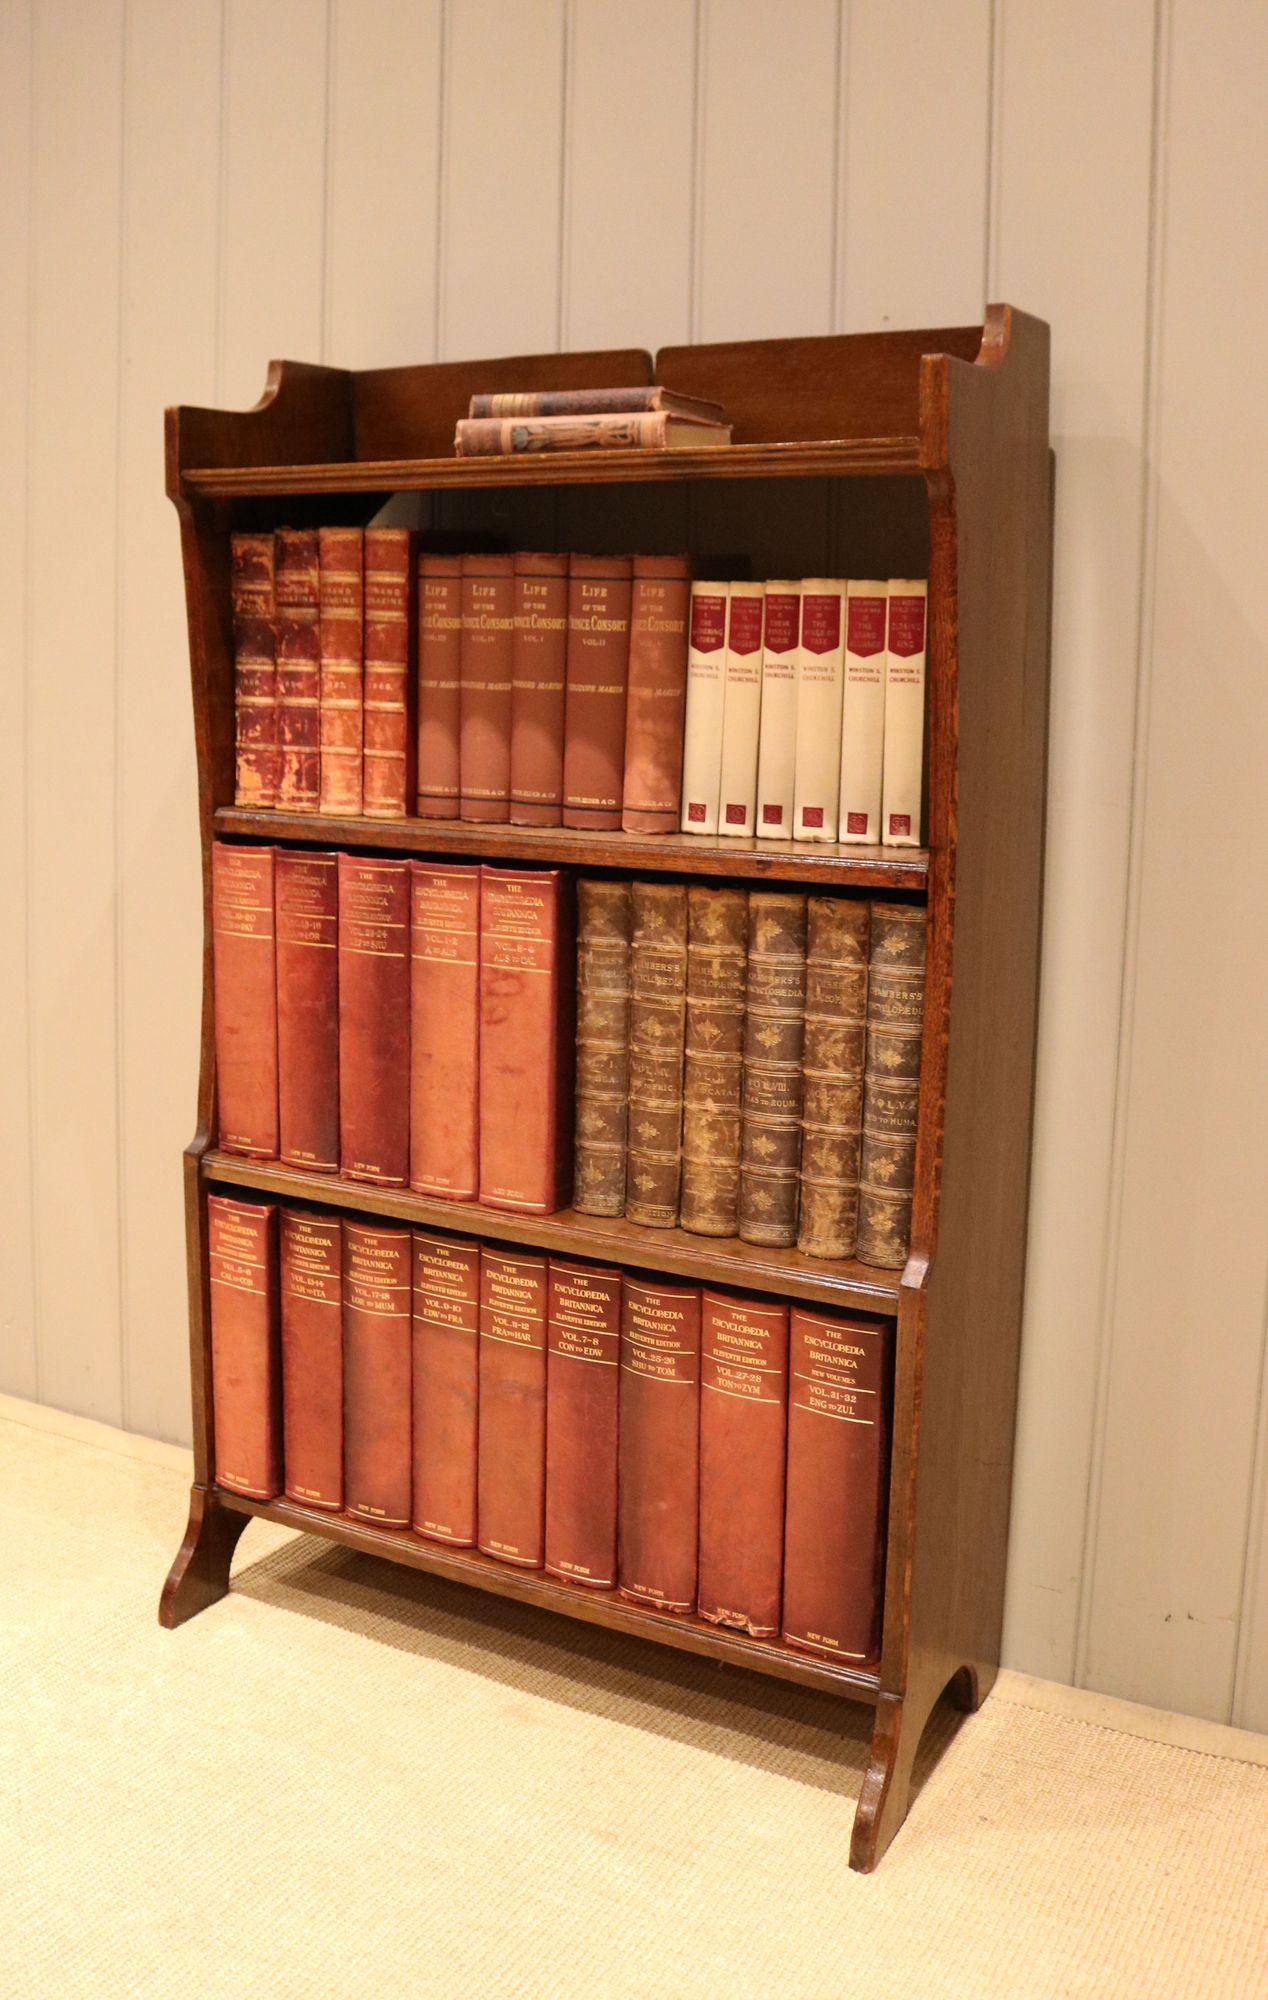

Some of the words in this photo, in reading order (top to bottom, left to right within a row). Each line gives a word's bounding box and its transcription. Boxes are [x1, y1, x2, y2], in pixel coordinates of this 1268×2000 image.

[582, 585, 608, 597] LIFE
[591, 616, 627, 632] CONSORT
[299, 1225, 312, 1233] THE
[364, 1238, 379, 1246] THE
[436, 1249, 450, 1257] THE
[424, 1267, 465, 1283] BRITANNICA
[503, 1265, 518, 1274] THE
[573, 1278, 589, 1287] THE
[492, 1284, 533, 1300] BRITANNICA
[560, 1298, 604, 1314] BRITANNICA
[645, 1297, 661, 1306] THE
[448, 1314, 464, 1325] FRA
[732, 1313, 747, 1322] THE
[633, 1316, 677, 1333] BRITANNICA
[515, 1331, 532, 1342] HAR
[717, 1333, 763, 1350] BRITANNICA
[826, 1331, 843, 1340] THE
[559, 1342, 575, 1352] CON
[584, 1347, 603, 1357] EDW
[810, 1351, 858, 1369] BRITANNICA
[632, 1360, 647, 1370] SHU
[656, 1366, 676, 1377] TOM
[717, 1378, 733, 1388] TON
[831, 1392, 857, 1404] 31-32
[810, 1397, 827, 1410] ENG
[837, 1404, 856, 1416] ZUL
